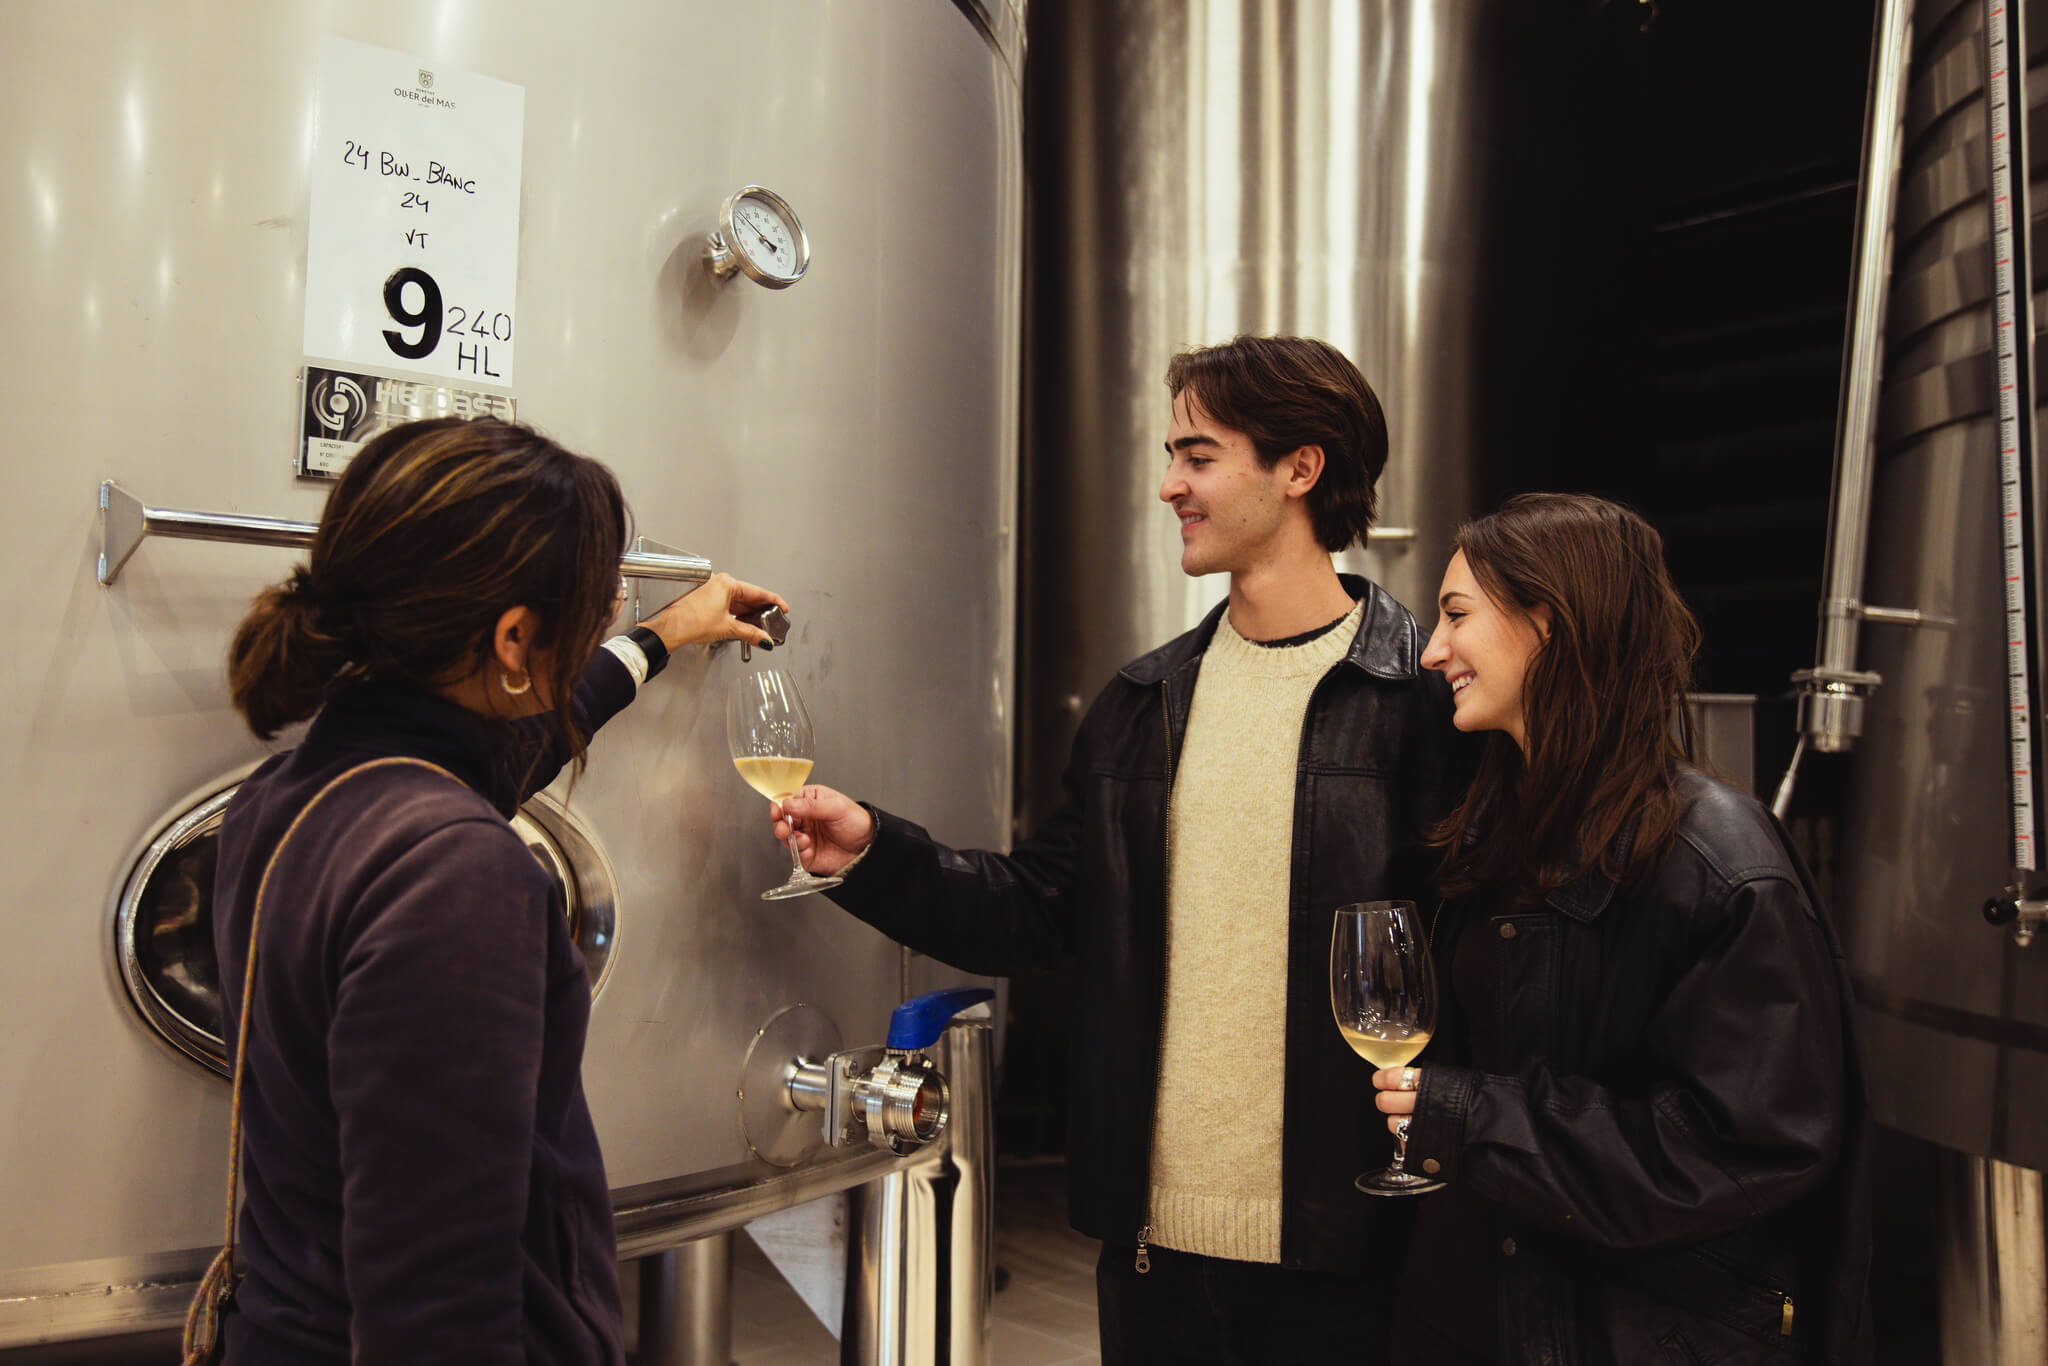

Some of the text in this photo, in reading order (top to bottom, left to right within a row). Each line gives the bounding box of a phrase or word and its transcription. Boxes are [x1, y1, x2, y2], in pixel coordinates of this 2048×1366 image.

[421, 95, 435, 105] del
[436, 98, 456, 109] MAS
[343, 140, 370, 170] 24
[400, 192, 429, 213] 24
[405, 229, 429, 249] VT
[382, 267, 443, 360] 9
[447, 306, 511, 341] 240
[458, 341, 501, 377] HL
